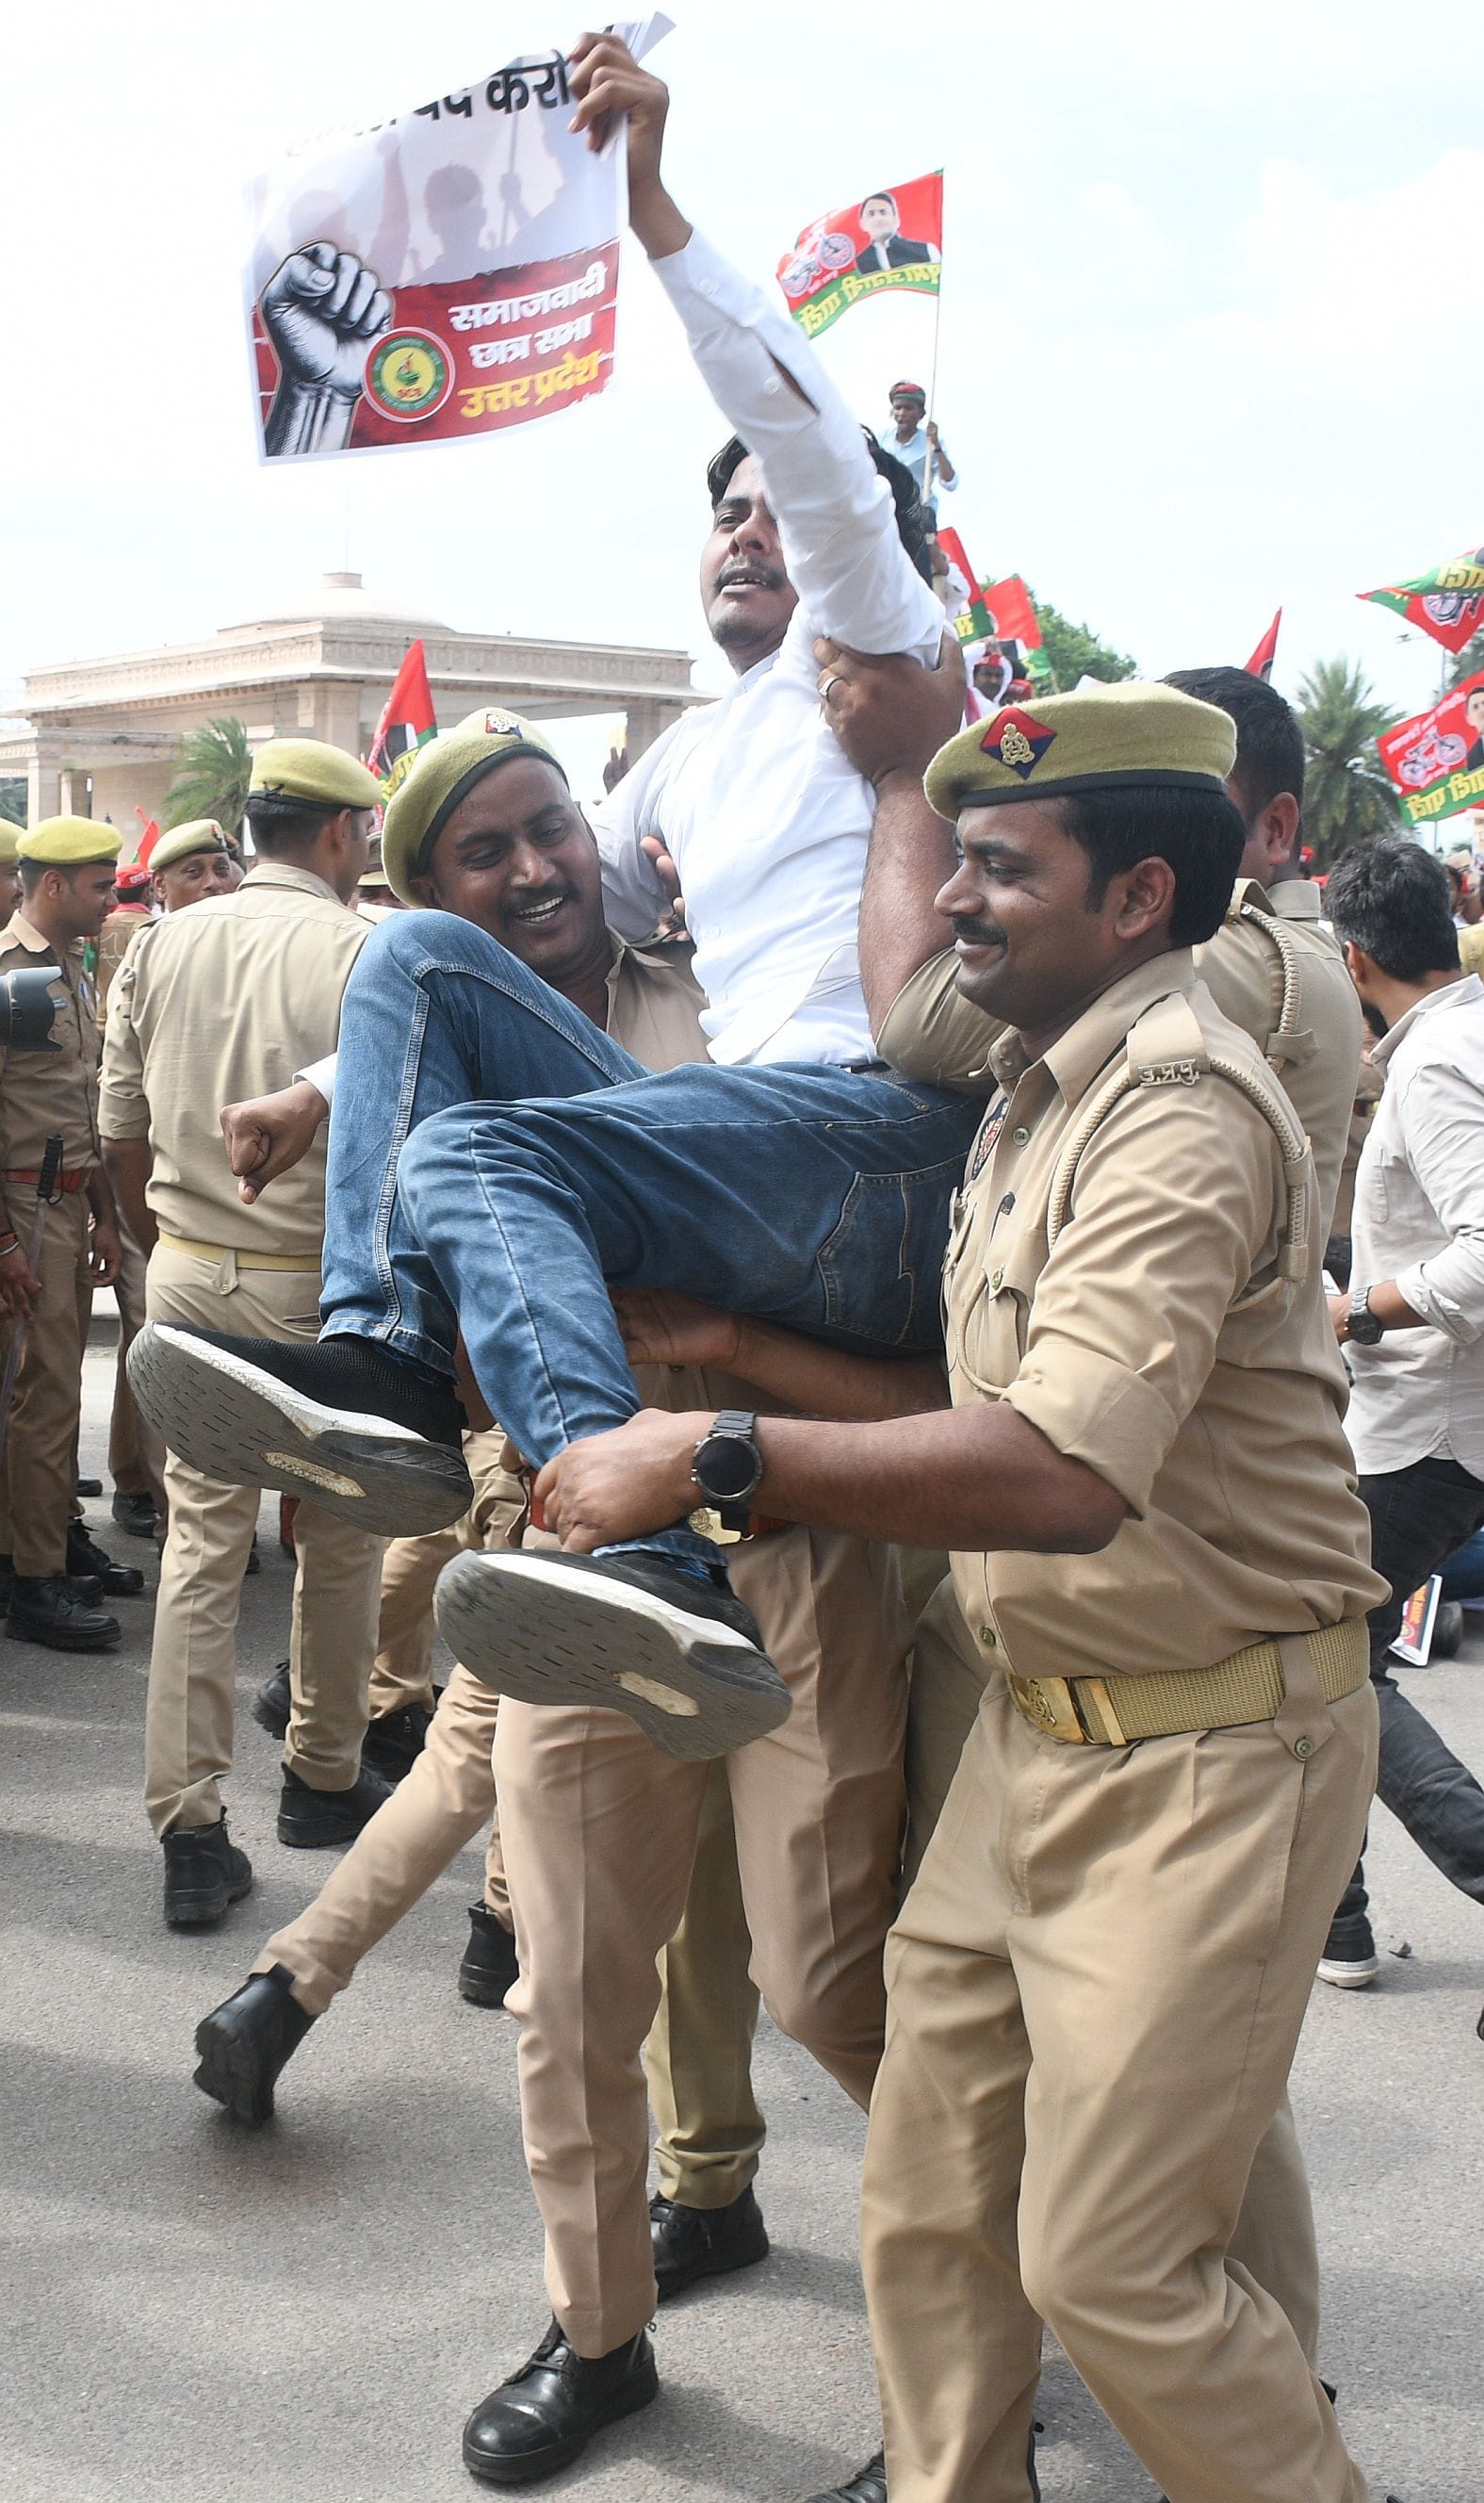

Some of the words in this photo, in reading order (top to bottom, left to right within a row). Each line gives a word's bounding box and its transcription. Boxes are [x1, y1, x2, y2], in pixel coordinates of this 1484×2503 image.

[448, 261, 608, 331] समाजवादी
[468, 334, 532, 368] छात्र
[533, 312, 595, 354] सभा
[456, 376, 531, 417] उत्तर
[534, 350, 602, 406] प्रदेश
